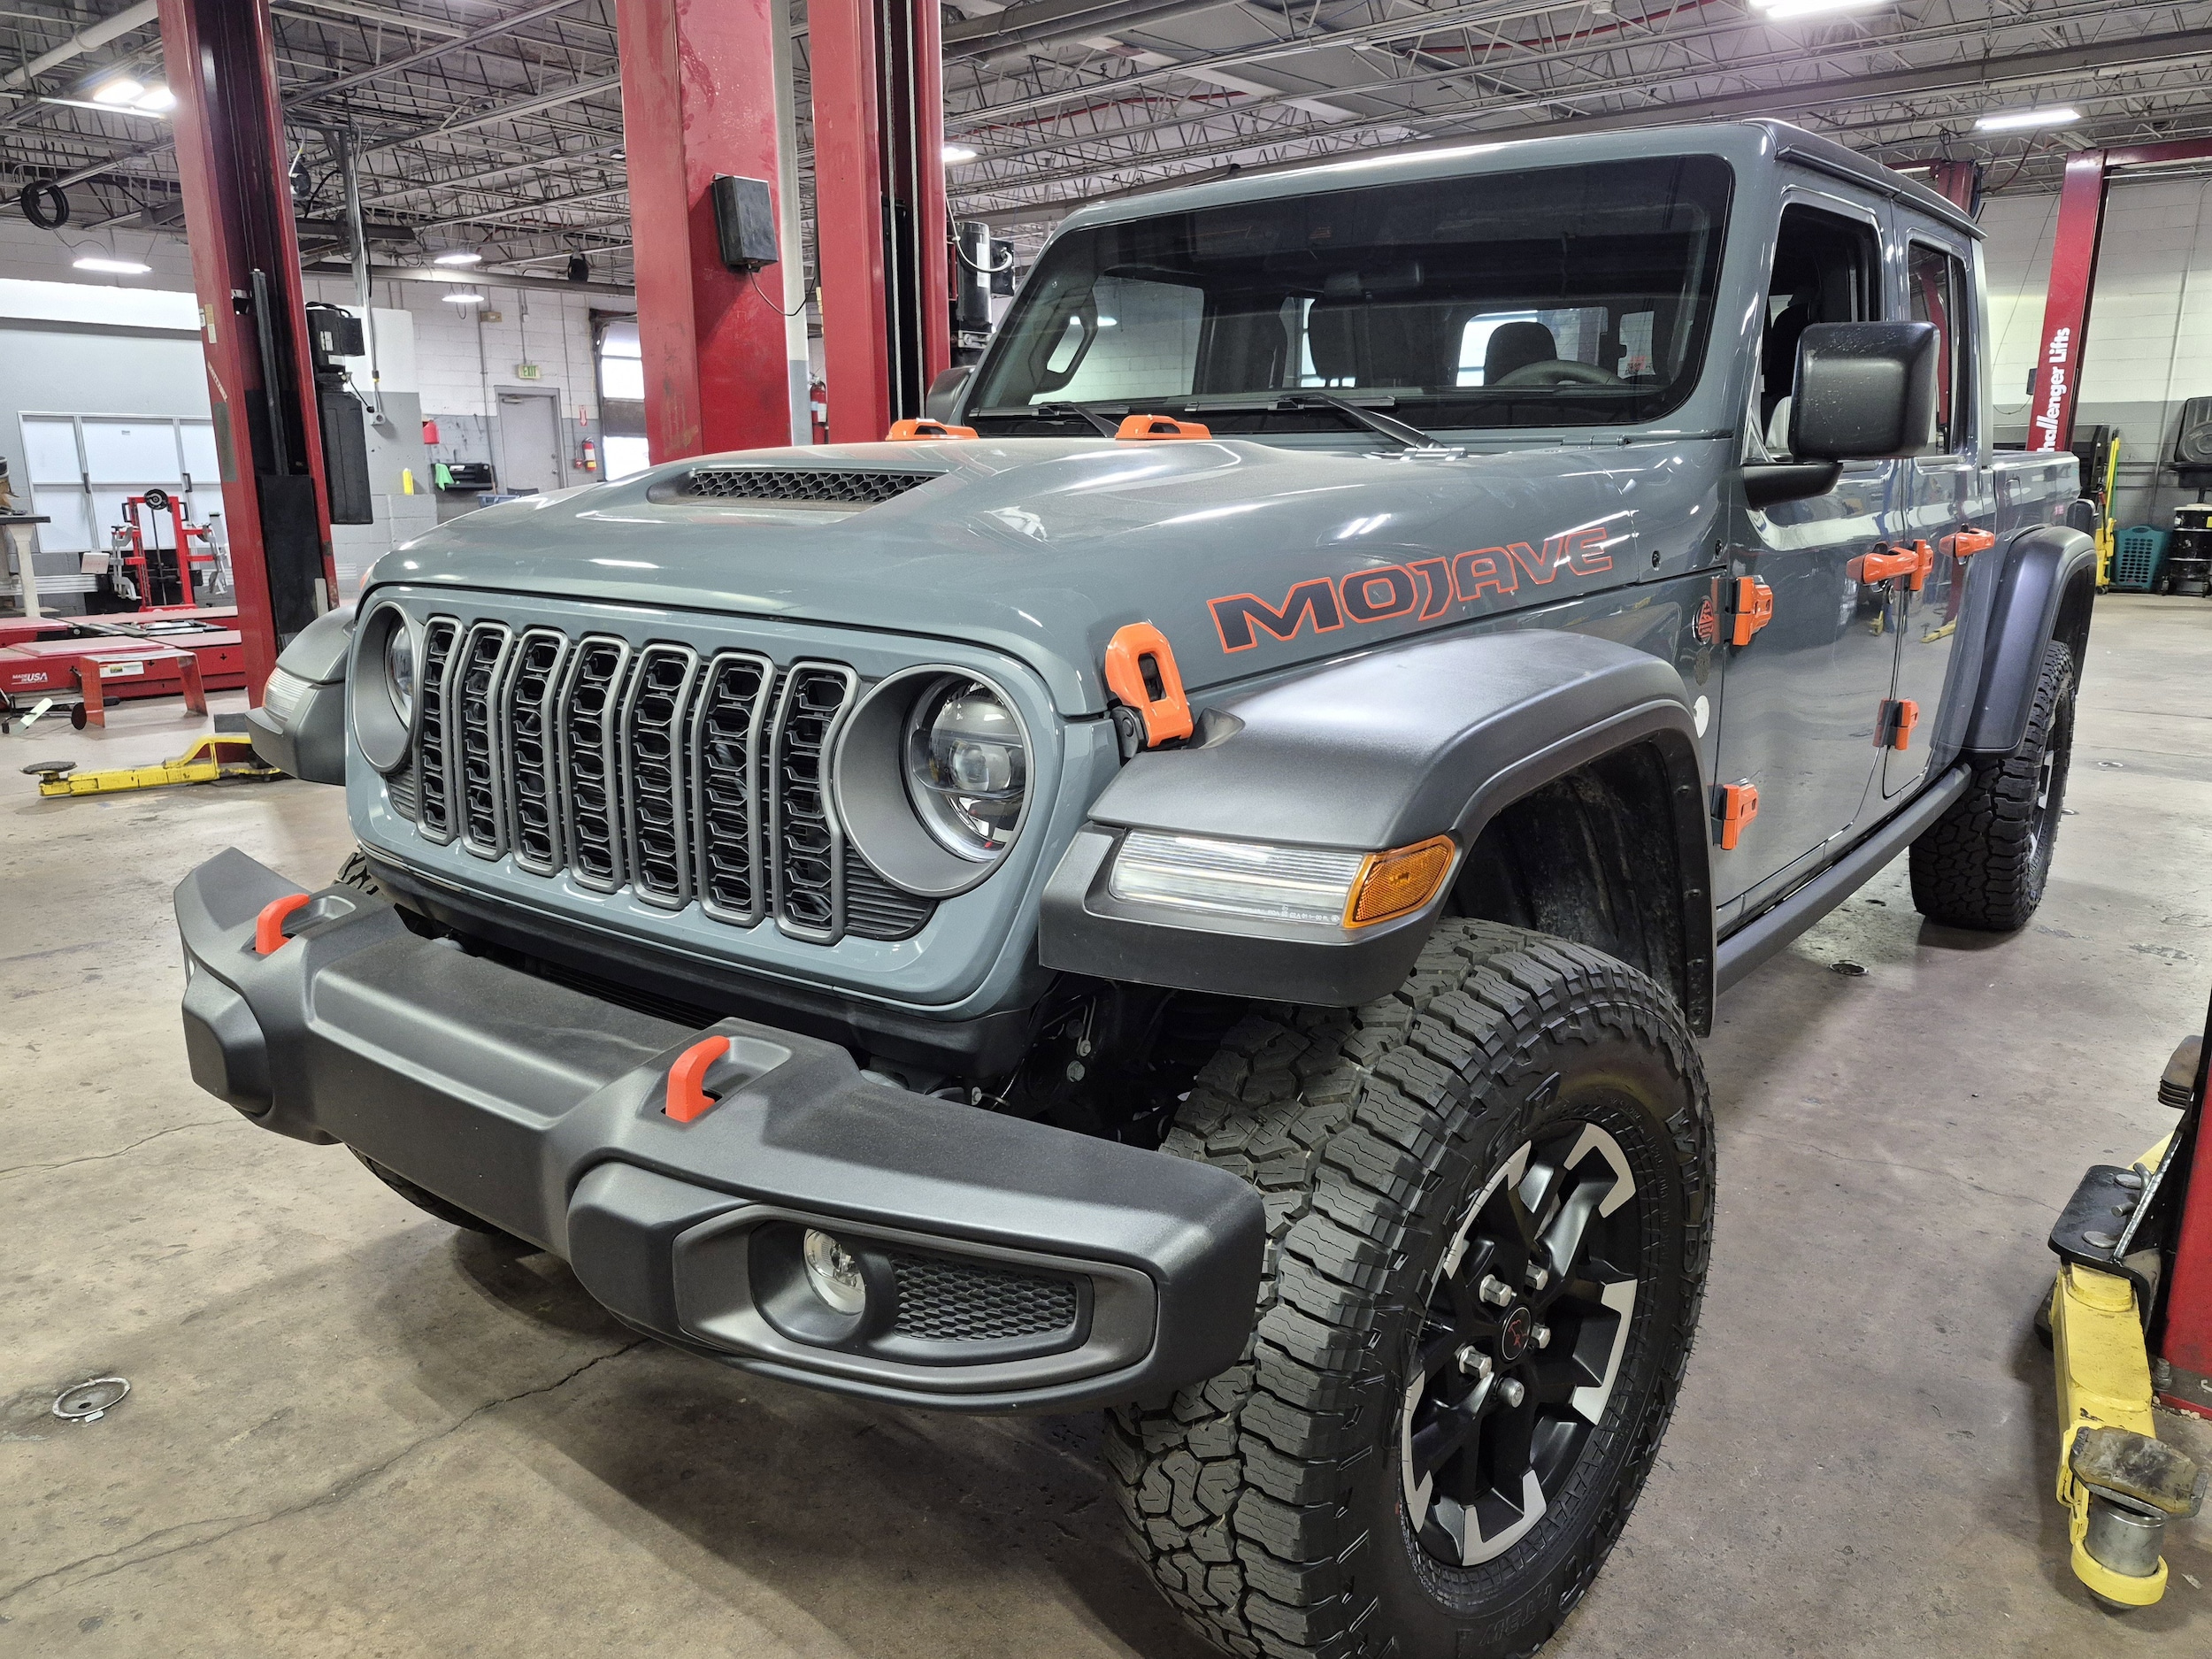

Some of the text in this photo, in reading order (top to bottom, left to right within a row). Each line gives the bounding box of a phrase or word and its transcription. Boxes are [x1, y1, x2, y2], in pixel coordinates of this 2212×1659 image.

[523, 365, 536, 377] EXIT
[2036, 326, 2070, 452] hallenger Lifts
[1206, 527, 1613, 654] MOJAVE
[27, 672, 48, 681] USA
